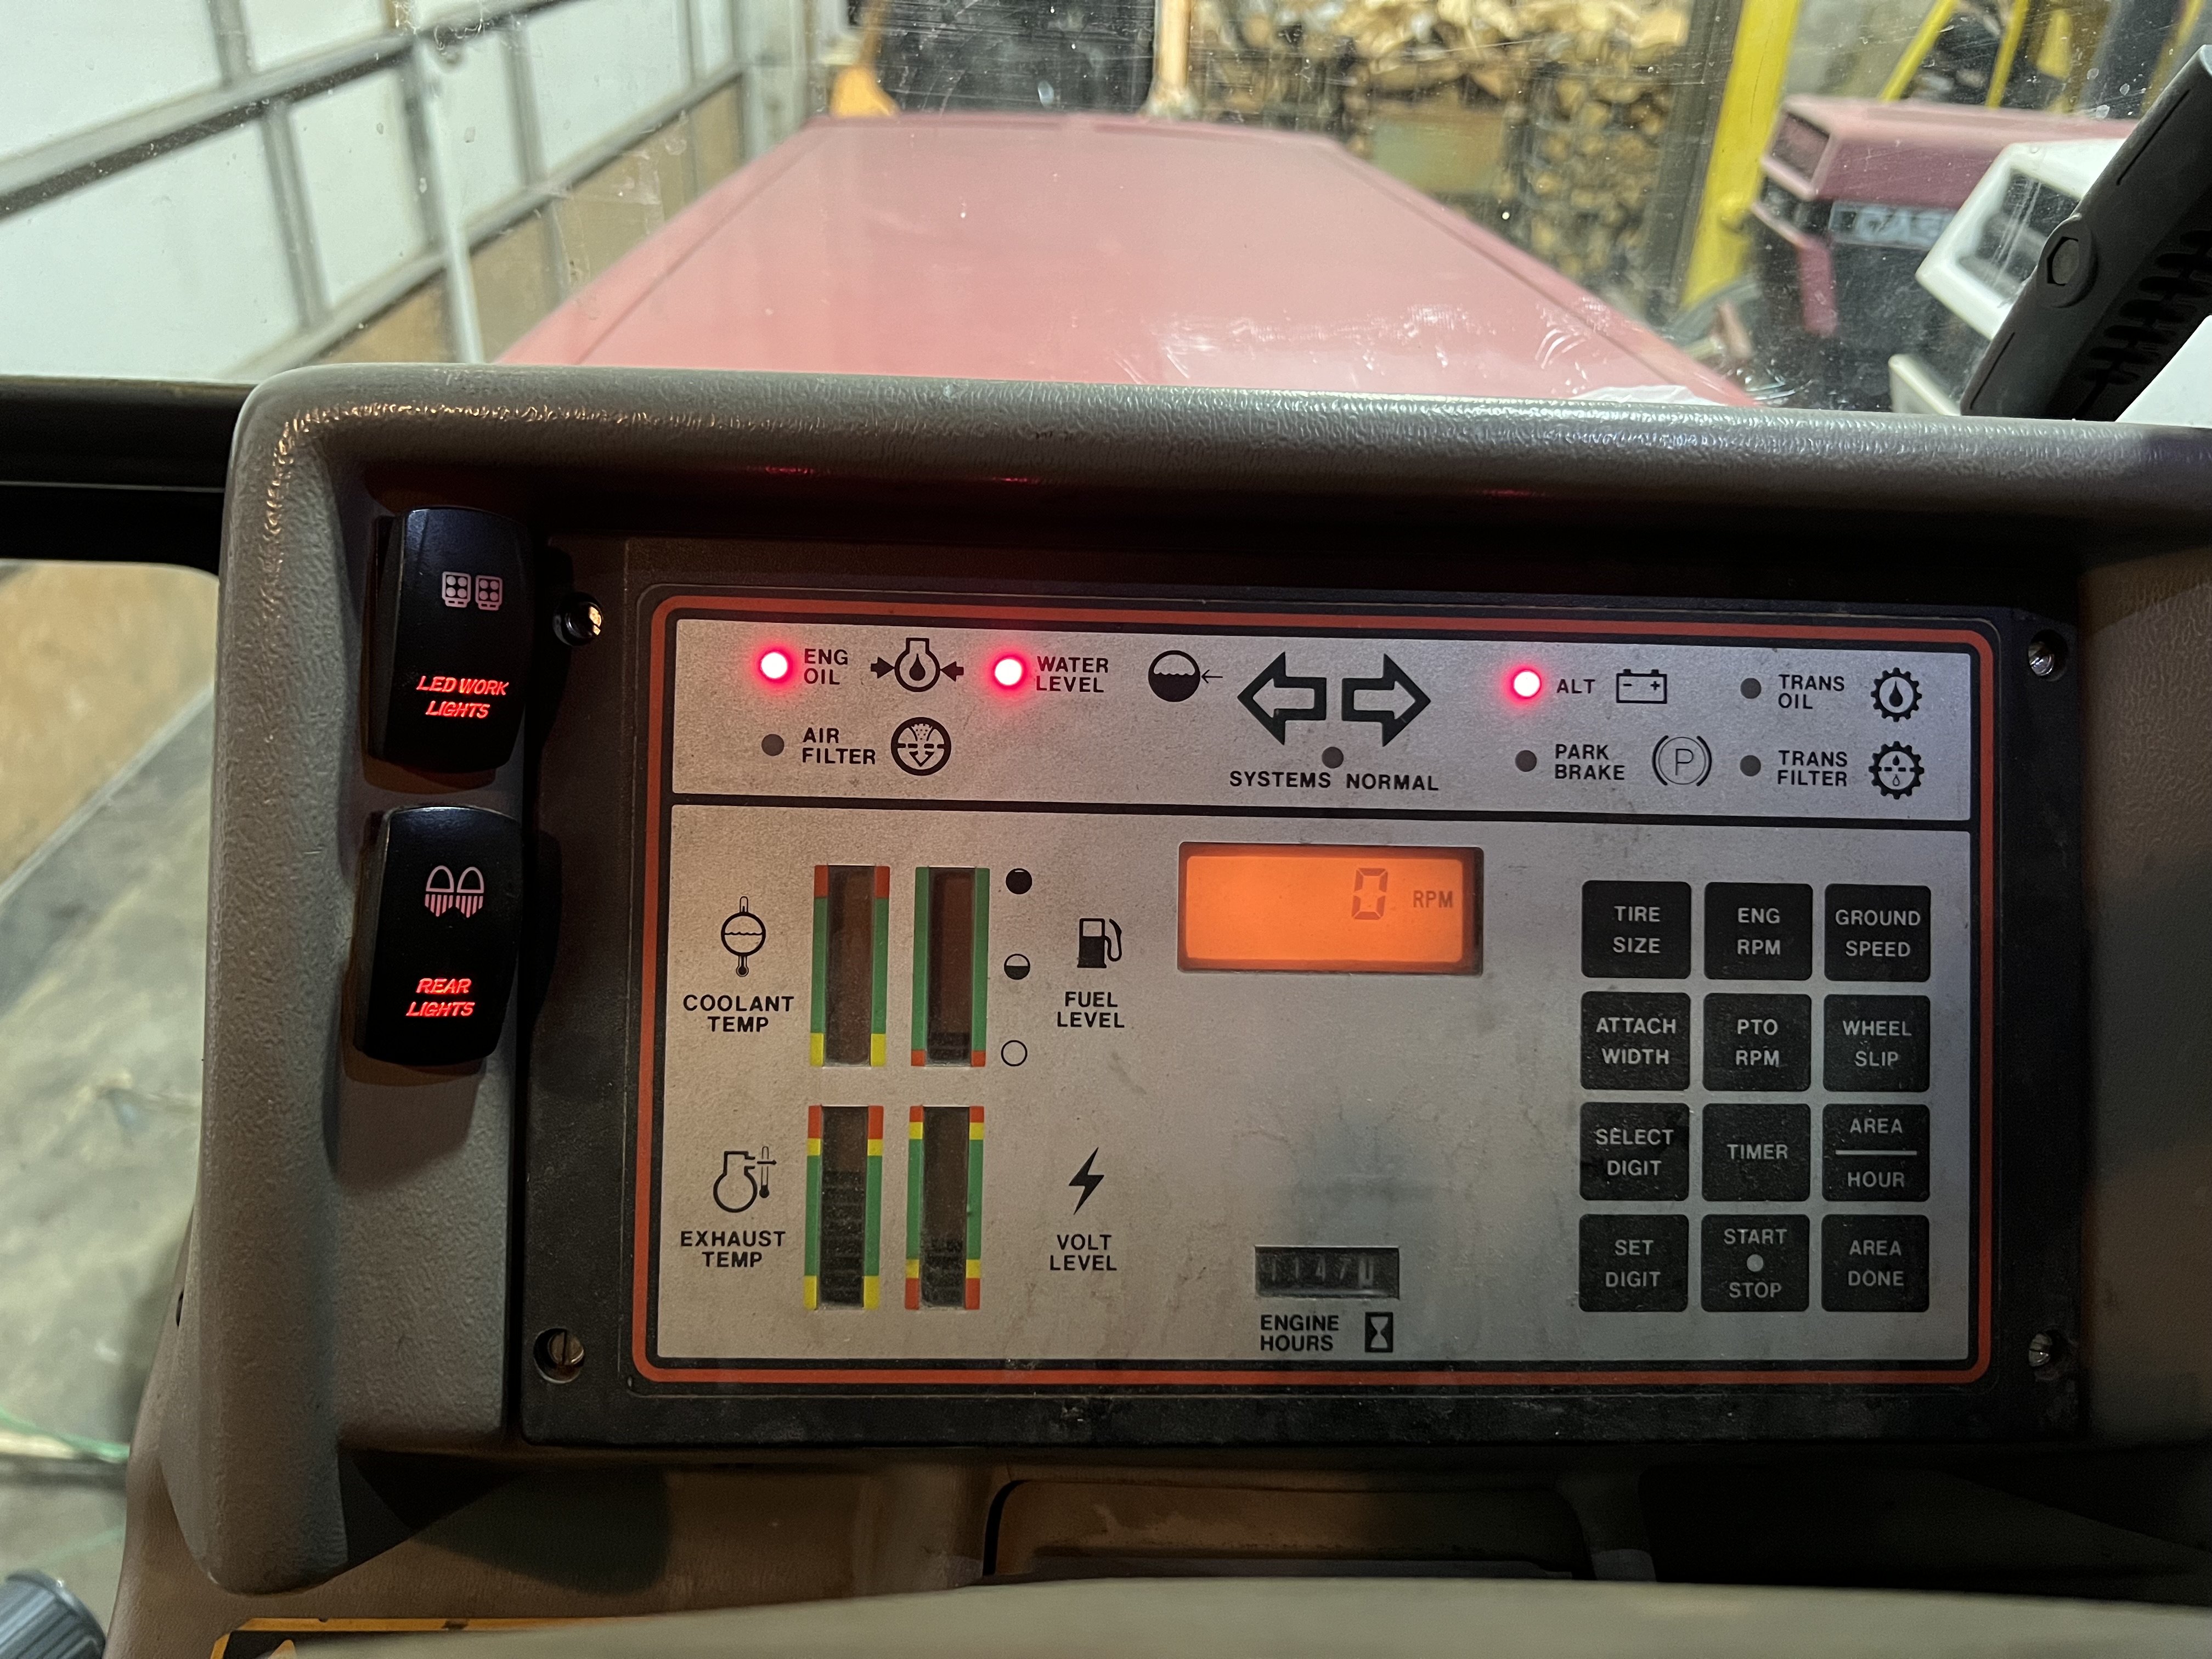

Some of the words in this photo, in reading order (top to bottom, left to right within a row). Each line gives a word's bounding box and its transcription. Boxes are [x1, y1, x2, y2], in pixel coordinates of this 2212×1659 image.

[804, 648, 848, 665] ENG
[1037, 656, 1109, 673] WATER
[804, 668, 840, 685] OIL
[1036, 675, 1104, 693] LEVEL
[1778, 674, 1845, 692] TRANS
[416, 676, 458, 693] LED
[458, 678, 510, 696] WORK
[1556, 679, 1596, 694] ALT
[1778, 692, 1813, 709] OIL
[425, 700, 491, 719] LIGHTS
[802, 727, 839, 744] AIR
[802, 747, 876, 765] FILTER
[1555, 743, 1609, 760] PARK
[1778, 750, 1848, 768] TRANS
[1675, 748, 1695, 776] P
[1229, 770, 1331, 788] SYSTEMS
[1346, 773, 1439, 791] NORMAL
[1555, 764, 1625, 781] BRAKE
[1778, 769, 1847, 787] FILTER
[1351, 867, 1389, 921] 0
[1412, 890, 1453, 908] RPM
[1614, 906, 1660, 922] TIRE
[1738, 907, 1780, 924] ENG
[1835, 909, 1921, 926] GROUND
[1613, 936, 1661, 953] SIZE
[1737, 939, 1780, 955] RPM
[1846, 940, 1911, 957] SPEED
[415, 978, 472, 995] REAR
[683, 994, 794, 1012] COOLANT
[1065, 991, 1118, 1008] FUEL
[405, 1001, 476, 1018] LIGHTS
[707, 1016, 769, 1032] TEMP
[1057, 1011, 1125, 1028] LEVEL
[1596, 1017, 1676, 1034] ATTACH
[1737, 1019, 1778, 1035] PTO
[1842, 1020, 1912, 1036] WHEEL
[1601, 1048, 1669, 1065] WIDTH
[1736, 1049, 1779, 1068] RPM
[1854, 1050, 1899, 1067] SLIP
[1849, 1118, 1903, 1133] AREA
[1595, 1128, 1674, 1146] SELECT
[1726, 1144, 1788, 1160] TIMER
[1607, 1159, 1662, 1176] DIGIT
[1847, 1171, 1904, 1188] HOUR
[680, 1230, 786, 1247] EXHAUST
[1057, 1233, 1112, 1251] VOLT
[1724, 1228, 1787, 1245] START
[1615, 1239, 1654, 1256] SET
[1849, 1239, 1901, 1256] AREA
[701, 1251, 763, 1268] TEMP
[1049, 1255, 1118, 1271] LEVEL
[1605, 1271, 1661, 1288] DIGIT
[1848, 1269, 1904, 1286] DONE
[1729, 1282, 1782, 1299] STOP
[1261, 1314, 1339, 1331] ENGINE
[1260, 1334, 1334, 1352] HOURS
